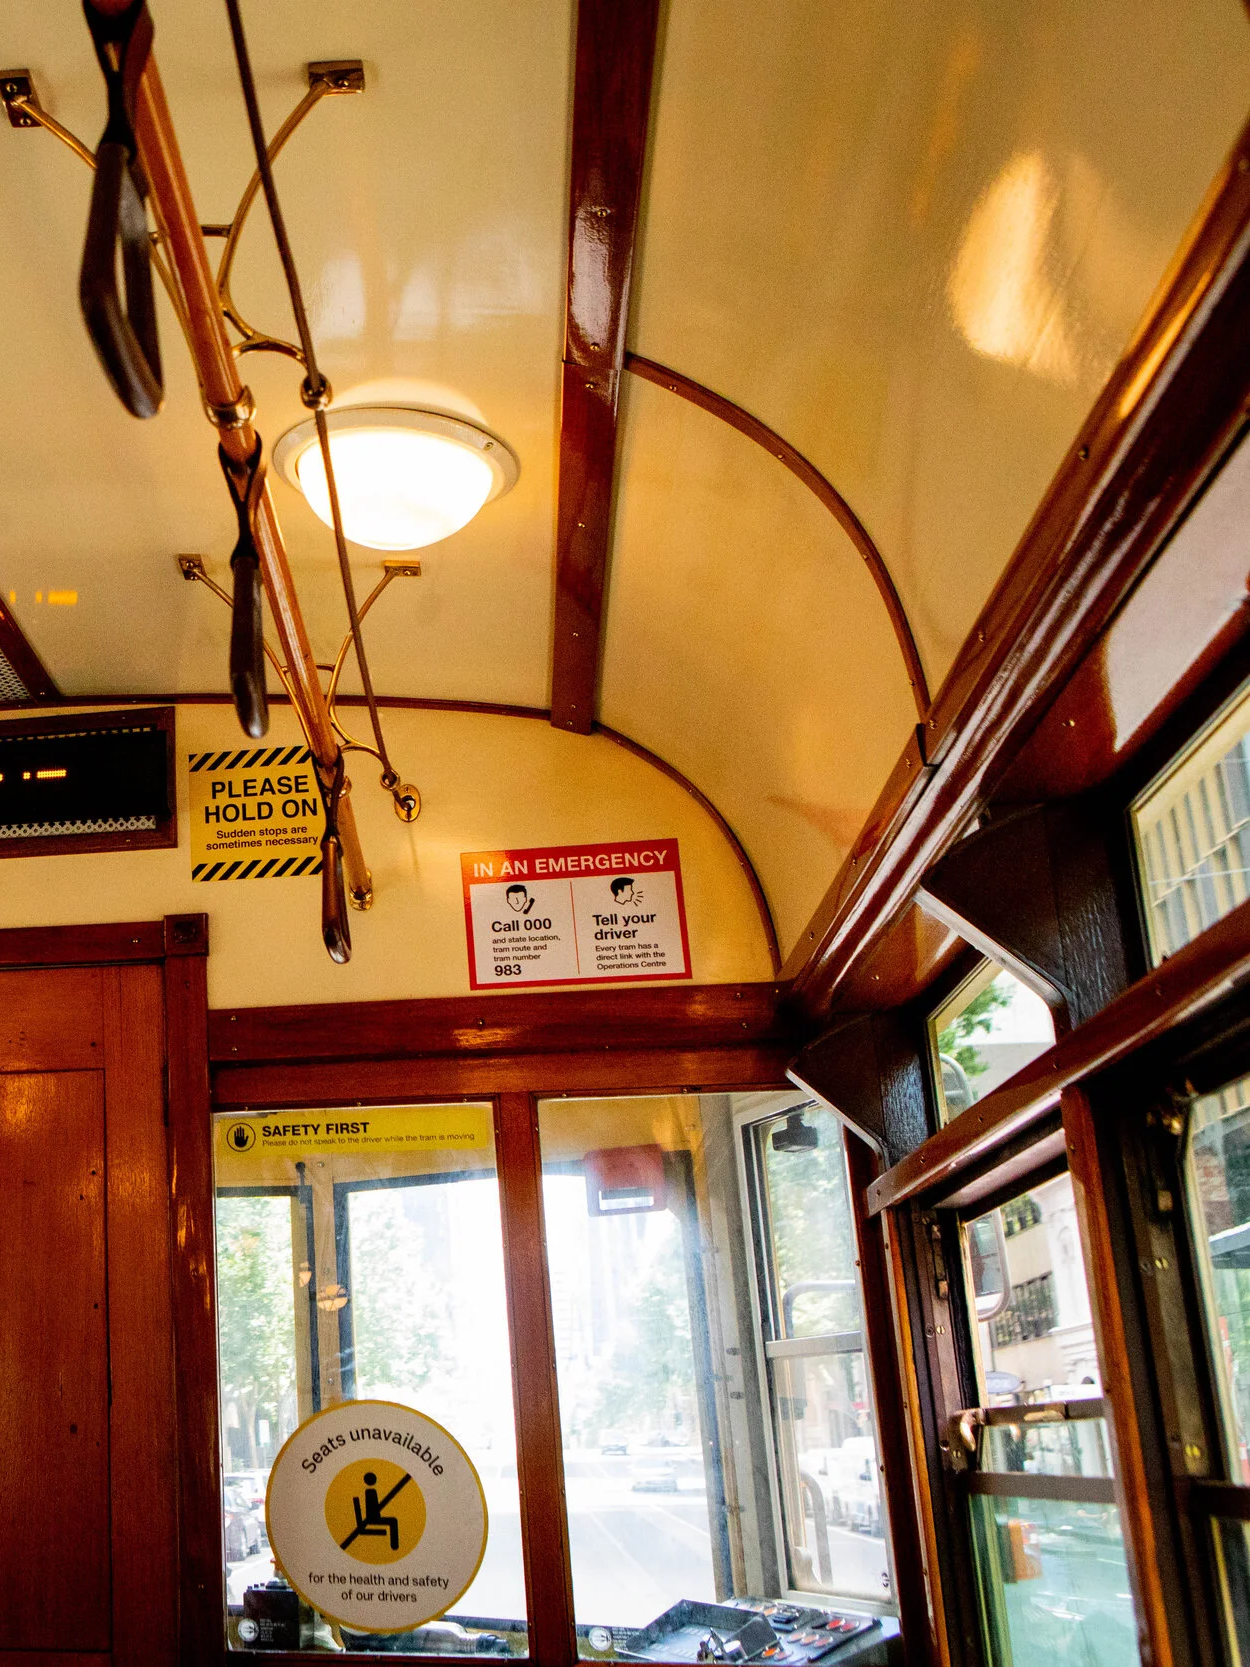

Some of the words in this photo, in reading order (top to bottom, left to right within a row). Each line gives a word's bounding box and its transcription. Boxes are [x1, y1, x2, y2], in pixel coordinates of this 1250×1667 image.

[211, 775, 310, 799] PLEASE
[205, 801, 274, 824] HOLD
[281, 798, 318, 818] ON
[216, 828, 256, 839] Sudden
[259, 827, 288, 838] stops
[291, 826, 308, 834] are
[206, 839, 262, 850] sometimes
[265, 836, 319, 847] necessary
[473, 862, 493, 878] IN
[500, 860, 528, 876] AN
[535, 850, 668, 874] EMERGENCY
[491, 920, 520, 933] Call
[523, 918, 552, 930] 000
[592, 914, 618, 927] Tell
[622, 913, 656, 929] your
[528, 934, 561, 943] location,
[594, 927, 638, 941] driver
[533, 943, 547, 951] and
[595, 944, 616, 954] Every
[618, 943, 636, 951] tram
[494, 954, 511, 962] tram
[513, 953, 541, 961] number
[596, 953, 618, 961] direct
[620, 952, 633, 960] link
[494, 964, 522, 976] 983
[597, 961, 639, 971] Operations
[640, 960, 667, 968] Centre
[262, 1123, 321, 1138] SAFETY
[326, 1122, 370, 1135] FIRST
[262, 1138, 287, 1147] Please
[288, 1138, 298, 1146] do
[313, 1138, 336, 1147] speak
[361, 1135, 382, 1143] driver
[384, 1135, 403, 1143] while
[405, 1134, 418, 1142] the
[419, 1134, 437, 1142] tram
[447, 1132, 475, 1142] moving
[301, 1433, 347, 1474] Seats
[350, 1427, 445, 1477] unavailable
[309, 1572, 325, 1584] for
[328, 1573, 347, 1584] the
[350, 1574, 385, 1586] health
[388, 1575, 409, 1587] and
[412, 1576, 449, 1590] safety
[341, 1590, 353, 1601] of
[356, 1592, 375, 1601] our
[378, 1590, 417, 1603] drivers
